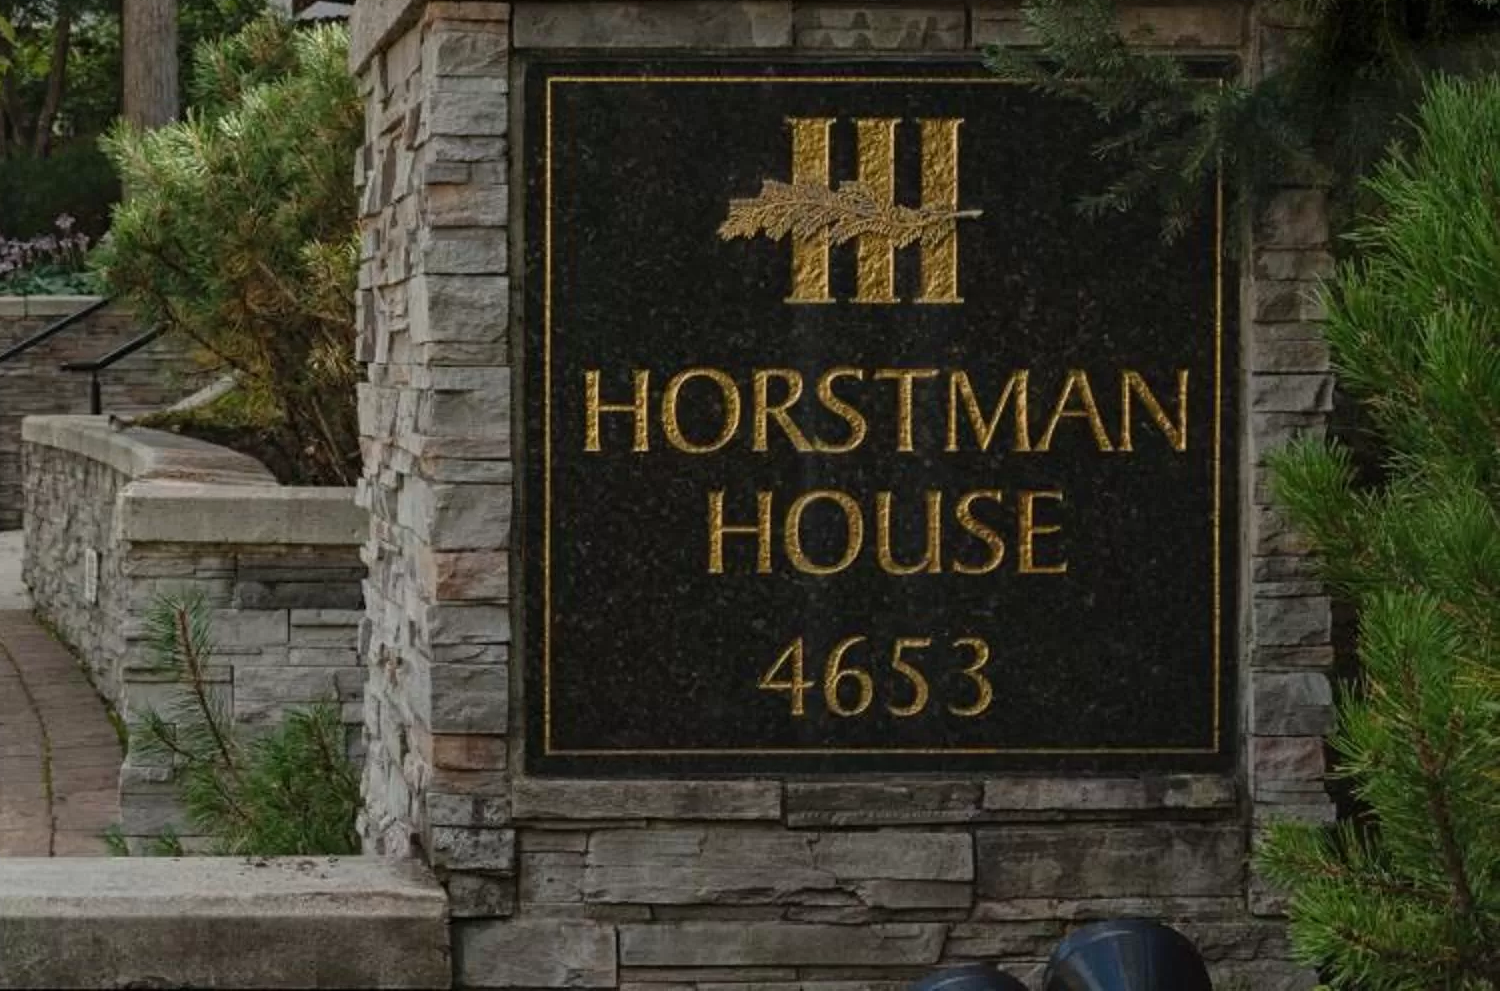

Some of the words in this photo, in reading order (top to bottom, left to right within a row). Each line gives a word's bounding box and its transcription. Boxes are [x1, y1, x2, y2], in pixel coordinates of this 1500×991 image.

[583, 369, 1190, 452] HORSTMAN
[707, 490, 1069, 575] HOUSE
[757, 637, 994, 716] 4653
